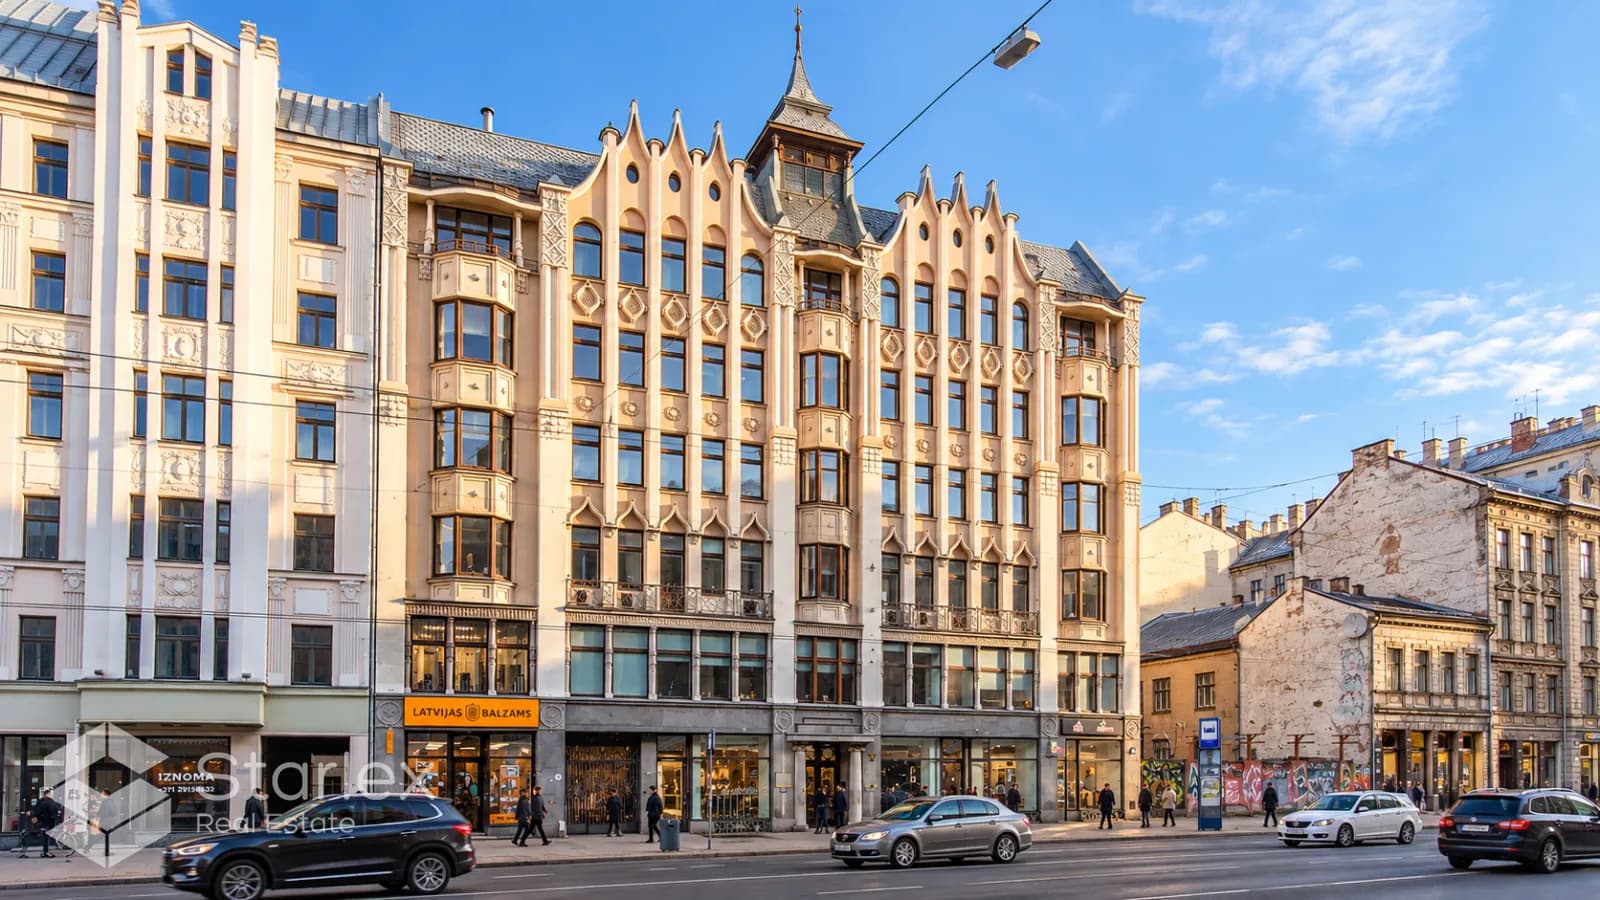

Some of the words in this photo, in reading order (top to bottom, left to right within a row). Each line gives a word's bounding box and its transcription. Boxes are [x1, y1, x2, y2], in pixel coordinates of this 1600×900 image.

[413, 707, 462, 719] LATVIJAS
[482, 709, 531, 719] BALZAMS
[158, 773, 215, 782] IZNOMA
